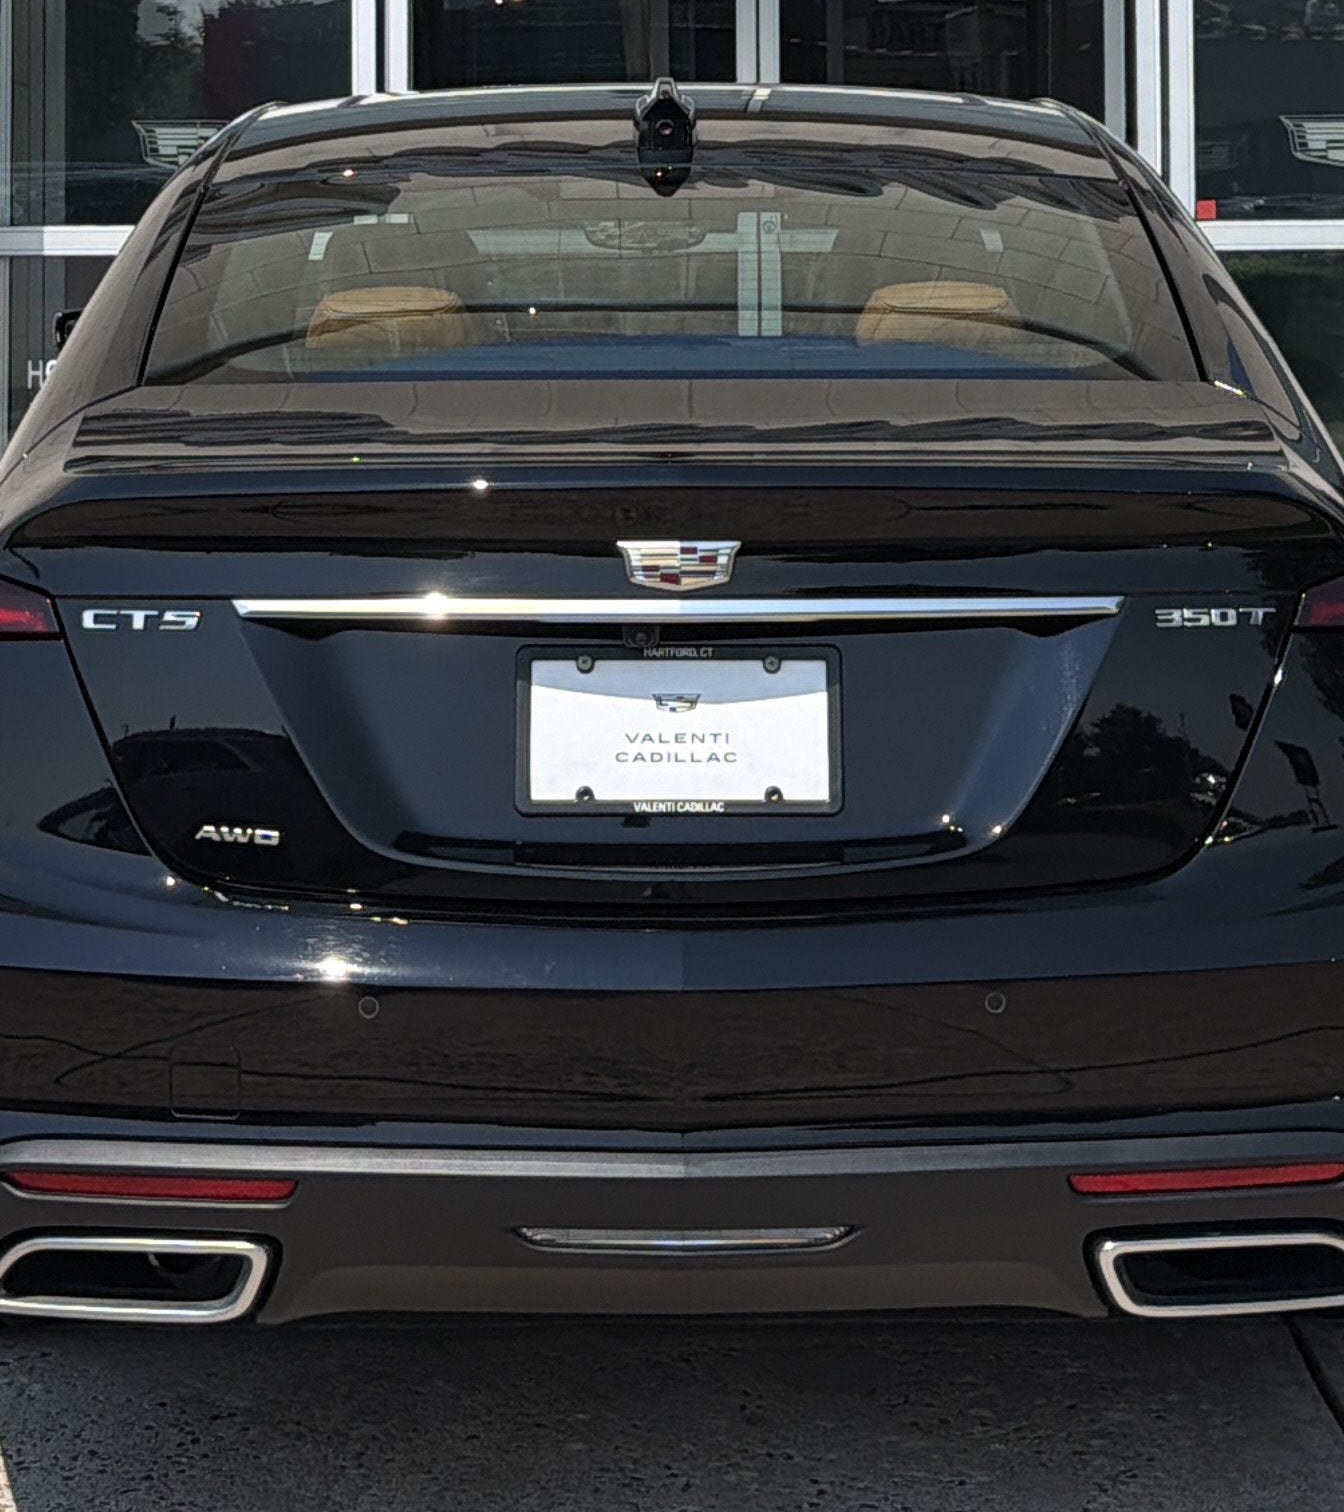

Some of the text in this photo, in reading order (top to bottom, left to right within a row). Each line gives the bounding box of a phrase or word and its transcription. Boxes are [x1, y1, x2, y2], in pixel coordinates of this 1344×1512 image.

[1154, 607, 1277, 628] 350T
[624, 732, 730, 744] VALENTI
[615, 751, 738, 763] CADILLAC
[633, 801, 725, 813] VALENTI CADILLAC
[194, 825, 280, 846] AWD
